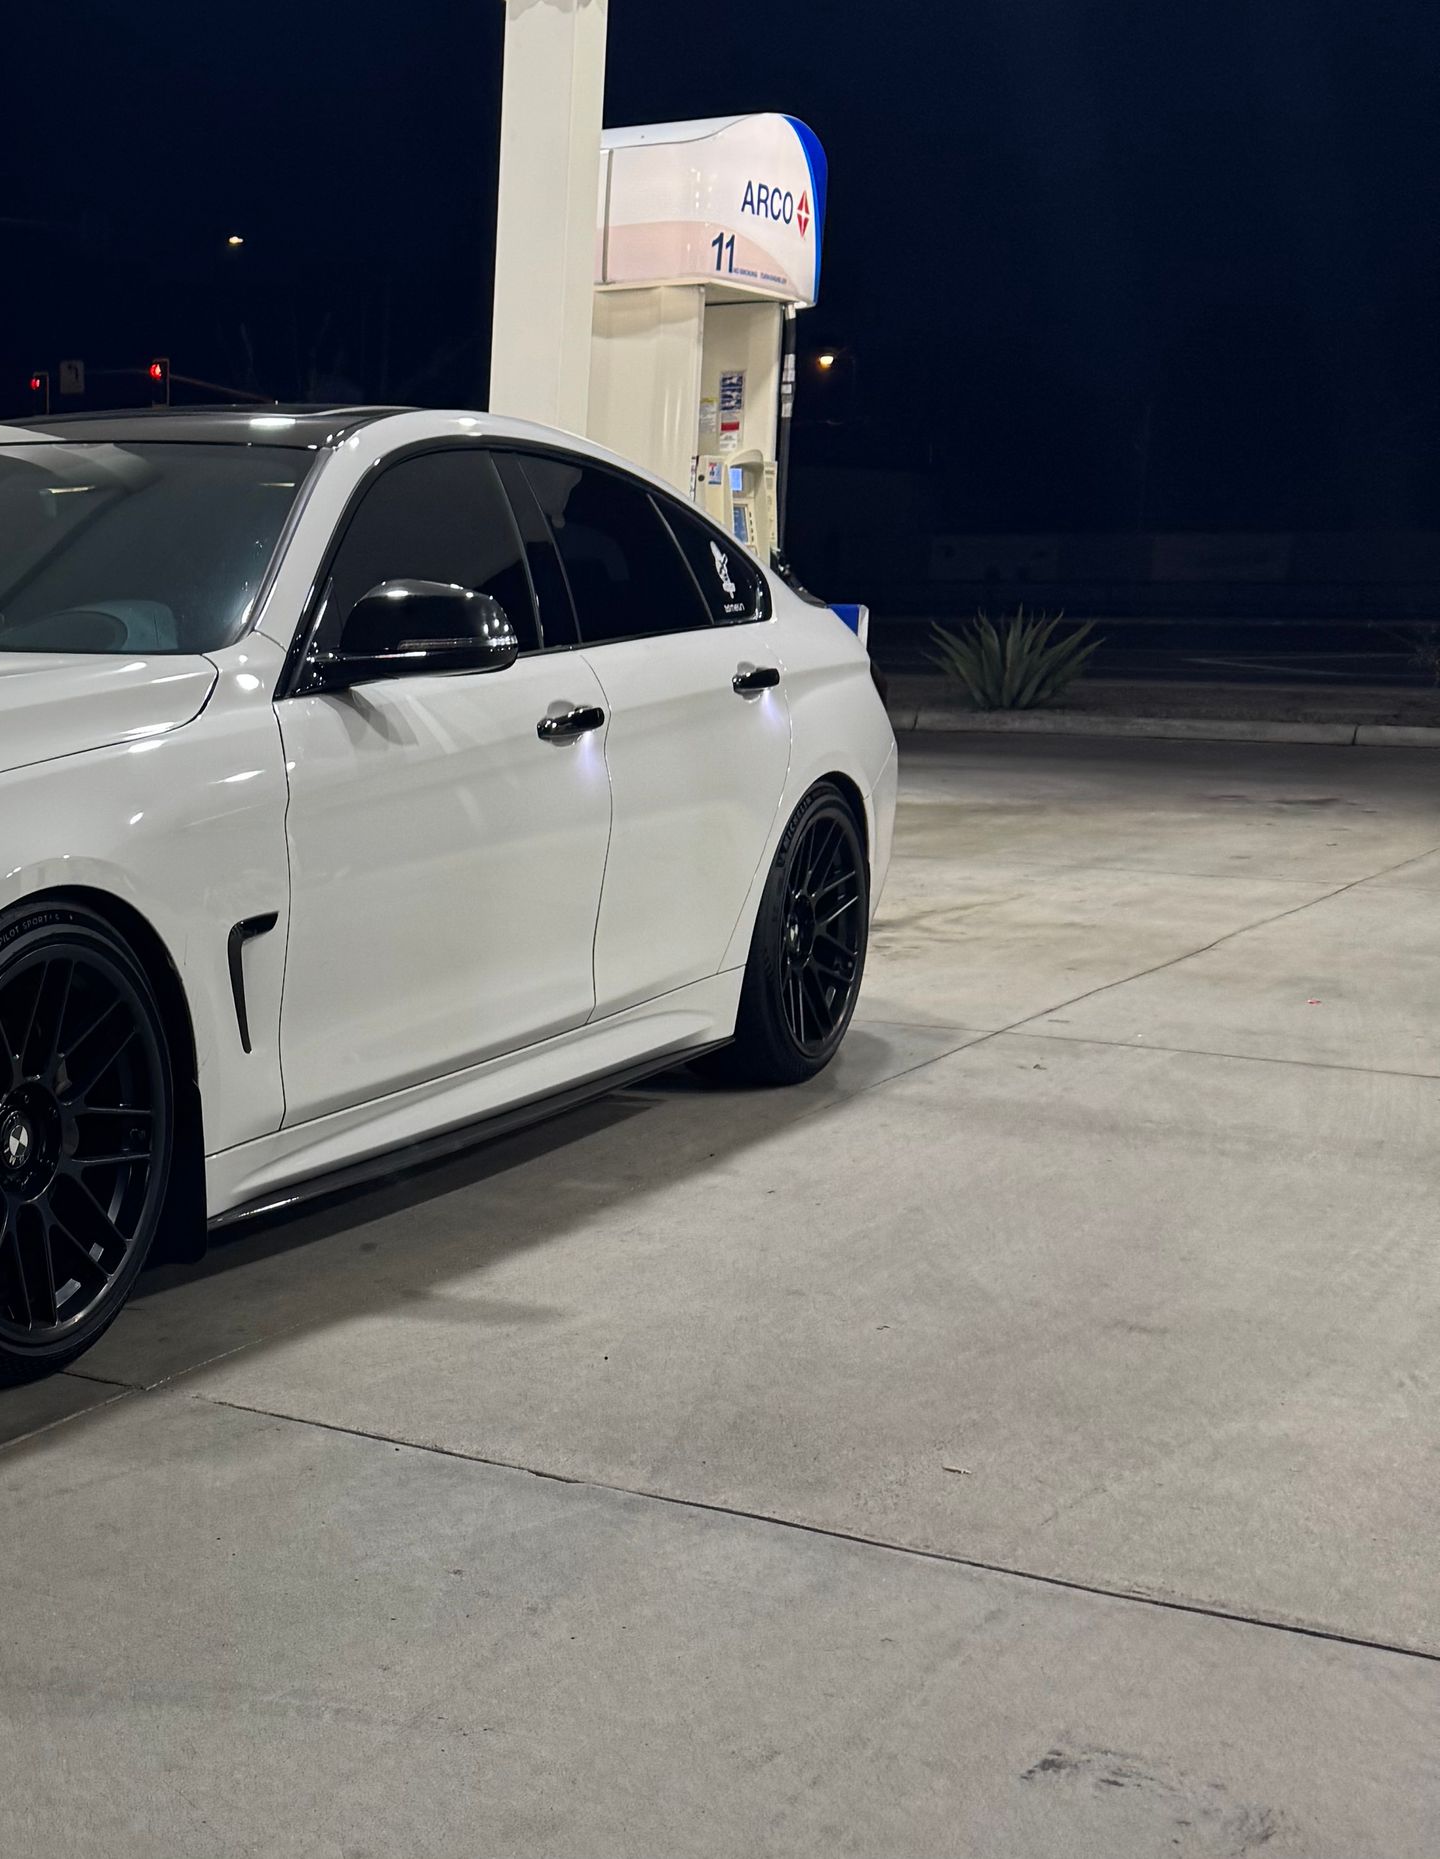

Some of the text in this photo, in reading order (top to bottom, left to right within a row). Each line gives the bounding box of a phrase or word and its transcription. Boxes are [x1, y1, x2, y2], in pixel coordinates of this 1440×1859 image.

[741, 180, 793, 224] ARCO
[712, 232, 735, 273] 11
[22, 914, 48, 931] SPORT
